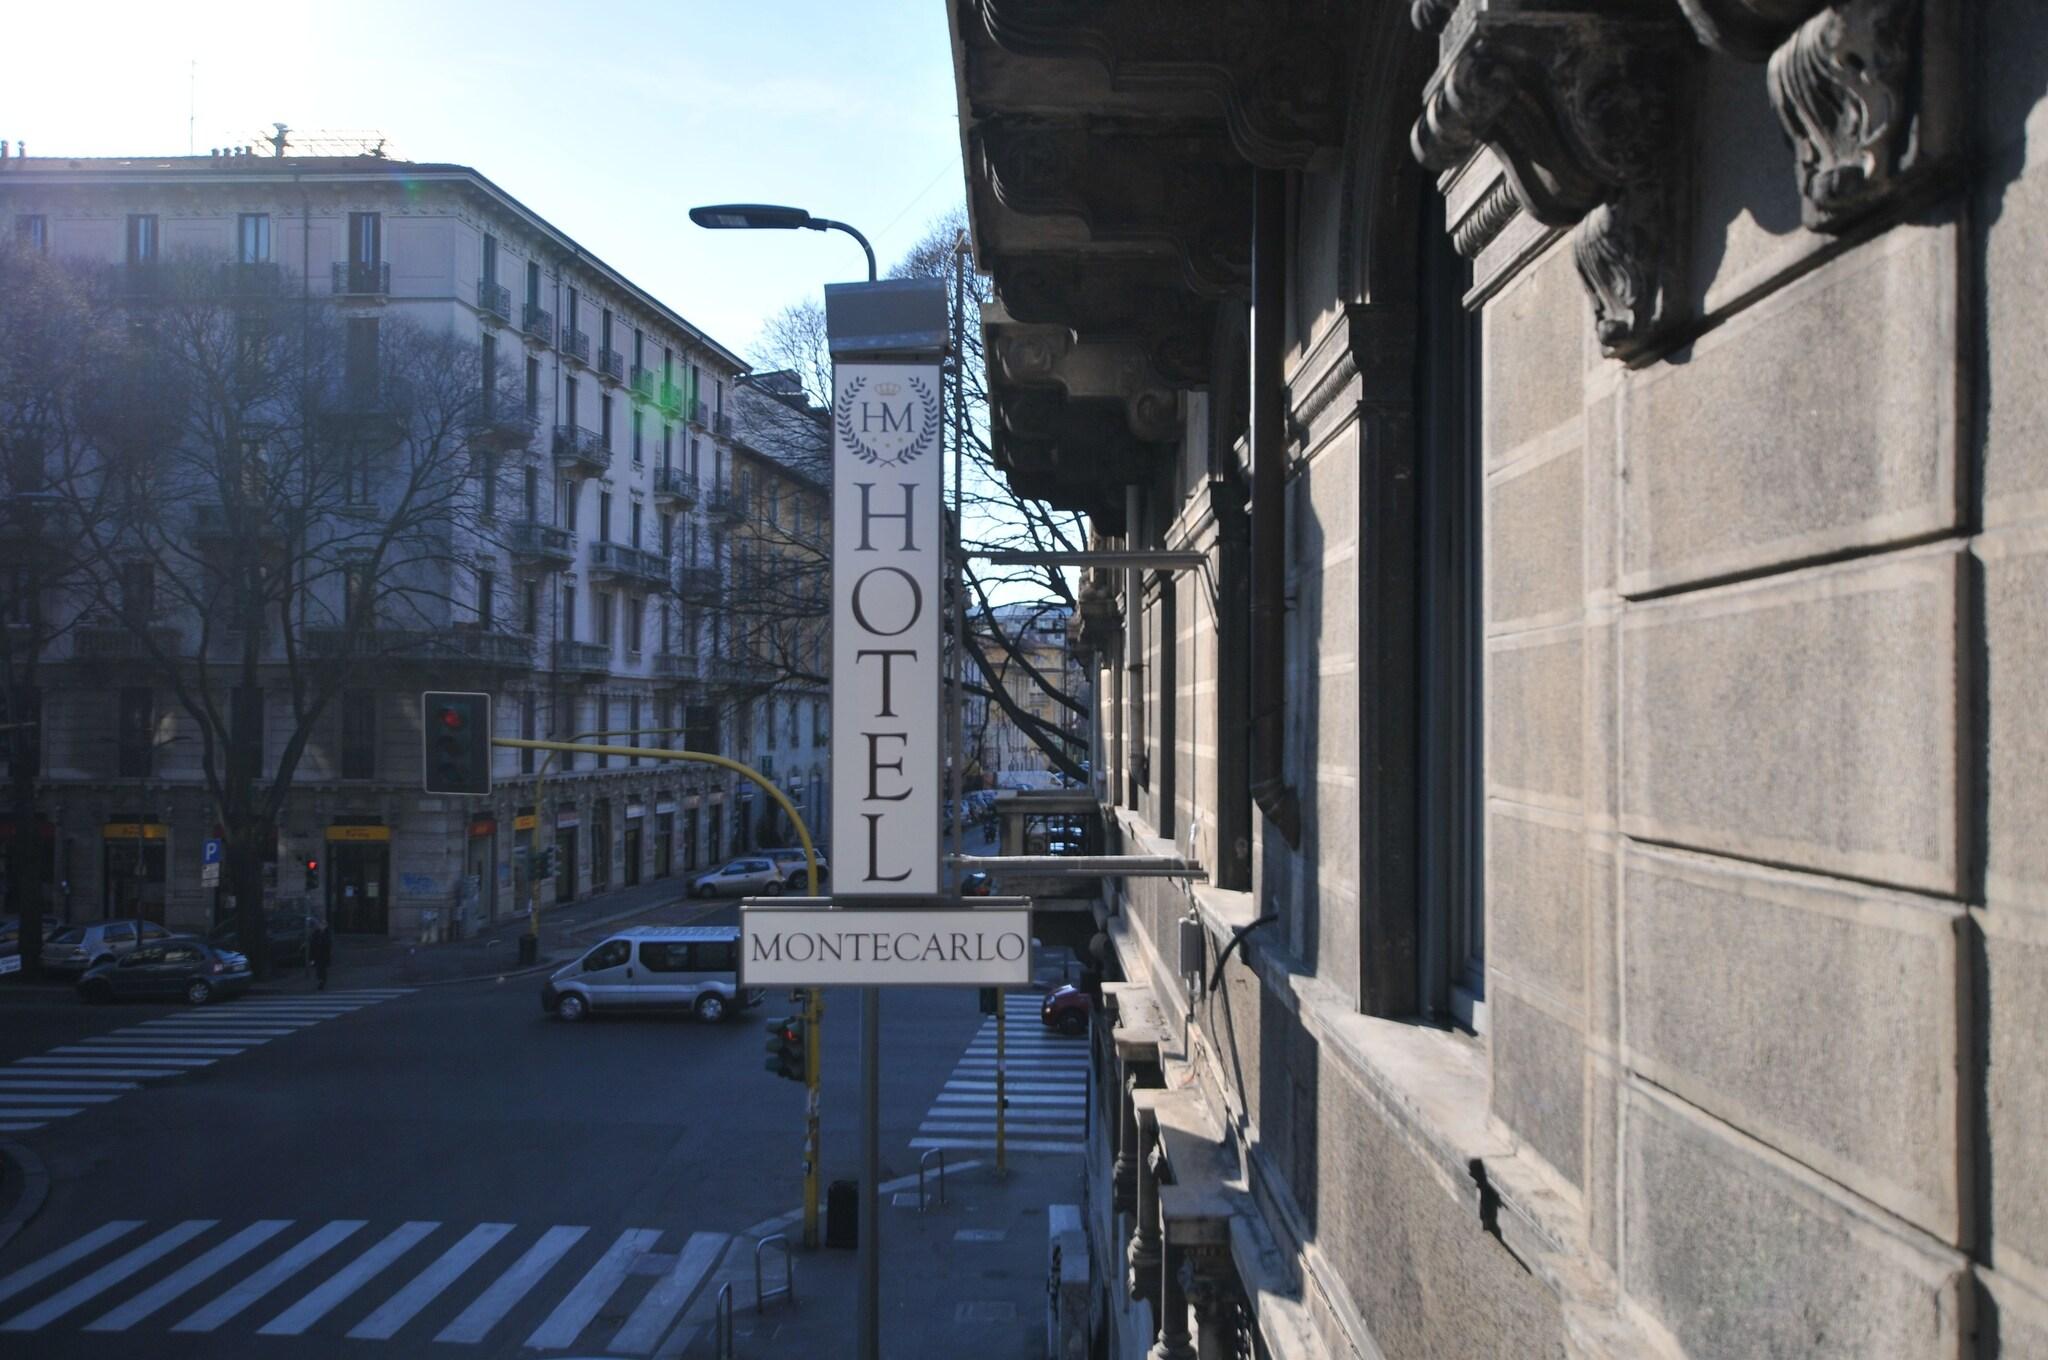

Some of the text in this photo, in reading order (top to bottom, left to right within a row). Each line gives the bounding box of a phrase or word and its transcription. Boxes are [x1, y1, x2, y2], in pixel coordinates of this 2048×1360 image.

[860, 401, 915, 434] HM
[851, 482, 923, 883] HOTEL
[205, 842, 217, 861] P
[751, 932, 1025, 962] MONTECARLO
